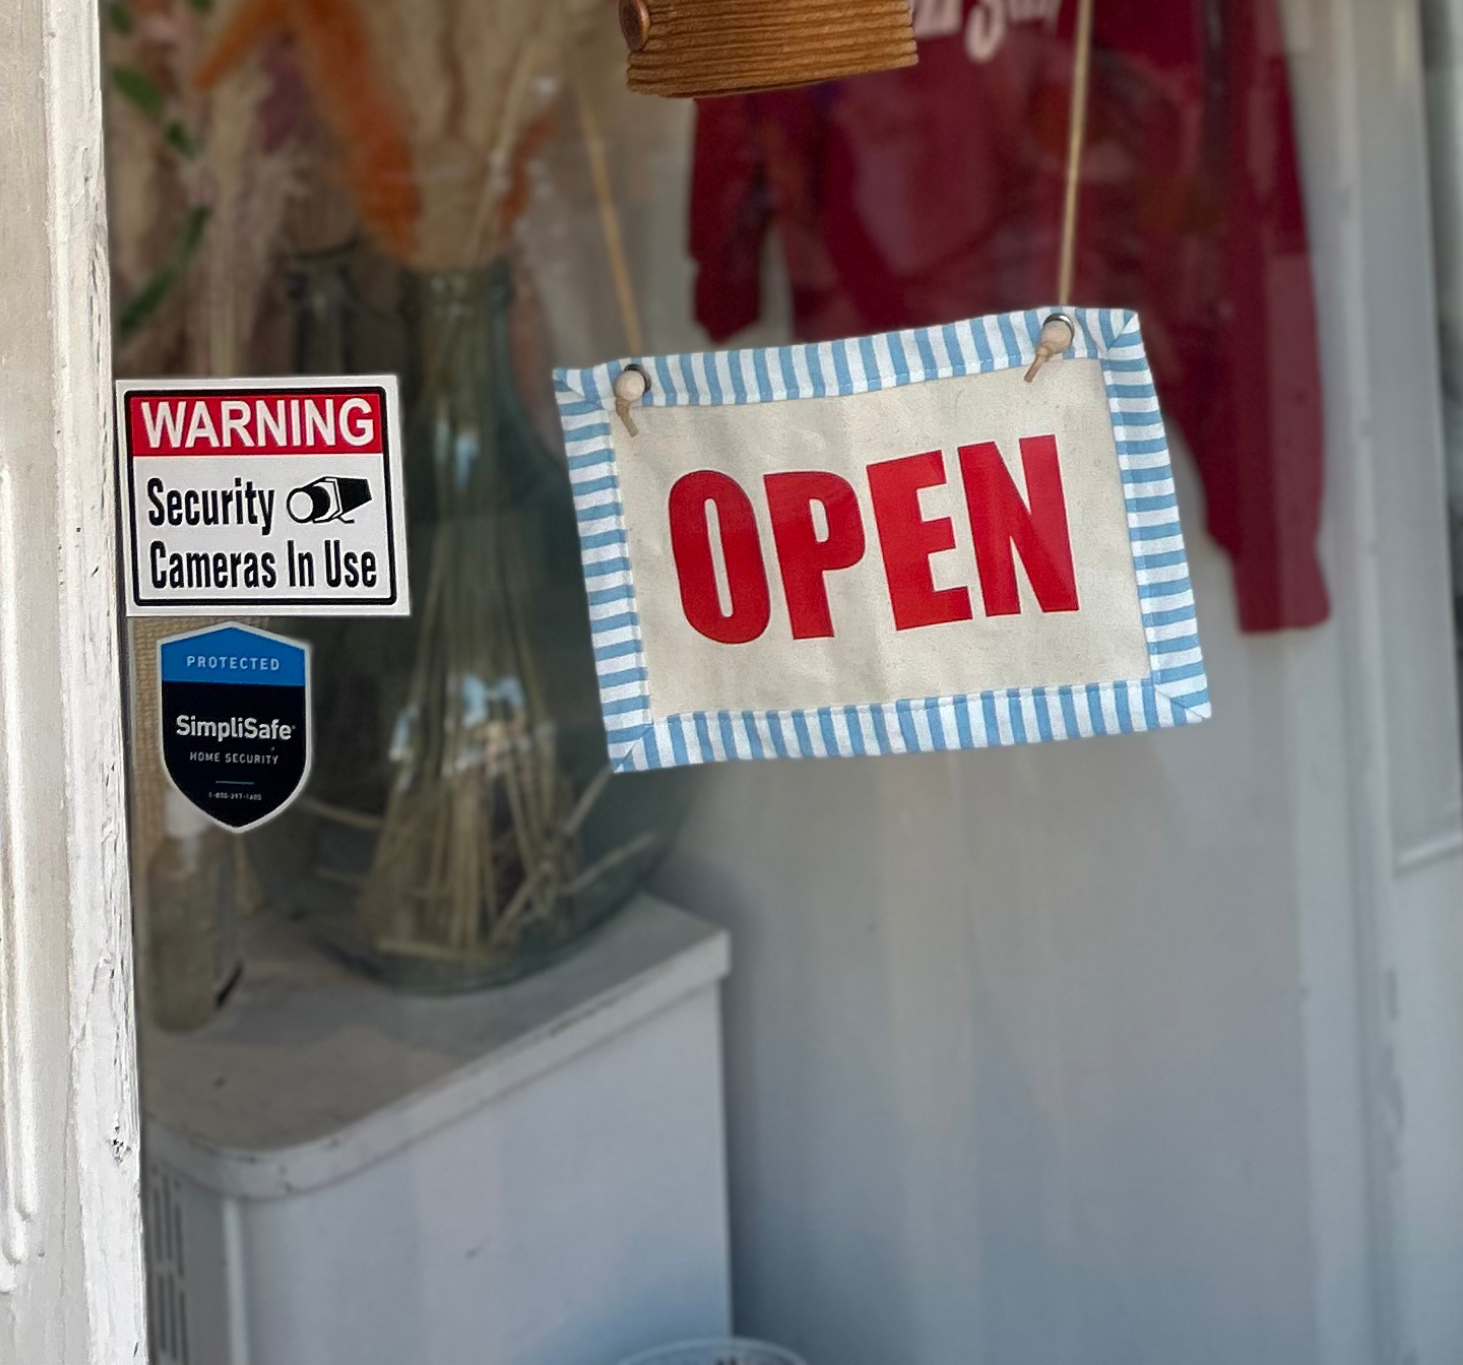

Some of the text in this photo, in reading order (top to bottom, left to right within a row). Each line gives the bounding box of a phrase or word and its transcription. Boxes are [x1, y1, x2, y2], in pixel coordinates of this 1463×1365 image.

[141, 398, 374, 448] WARNING
[147, 477, 275, 535] Security
[150, 539, 378, 590] Cameras In Use
[668, 434, 1080, 645] OPEN
[187, 655, 280, 671] PROTECTED
[176, 714, 292, 742] SimpliSafe
[190, 752, 279, 764] HOME SECURITY
